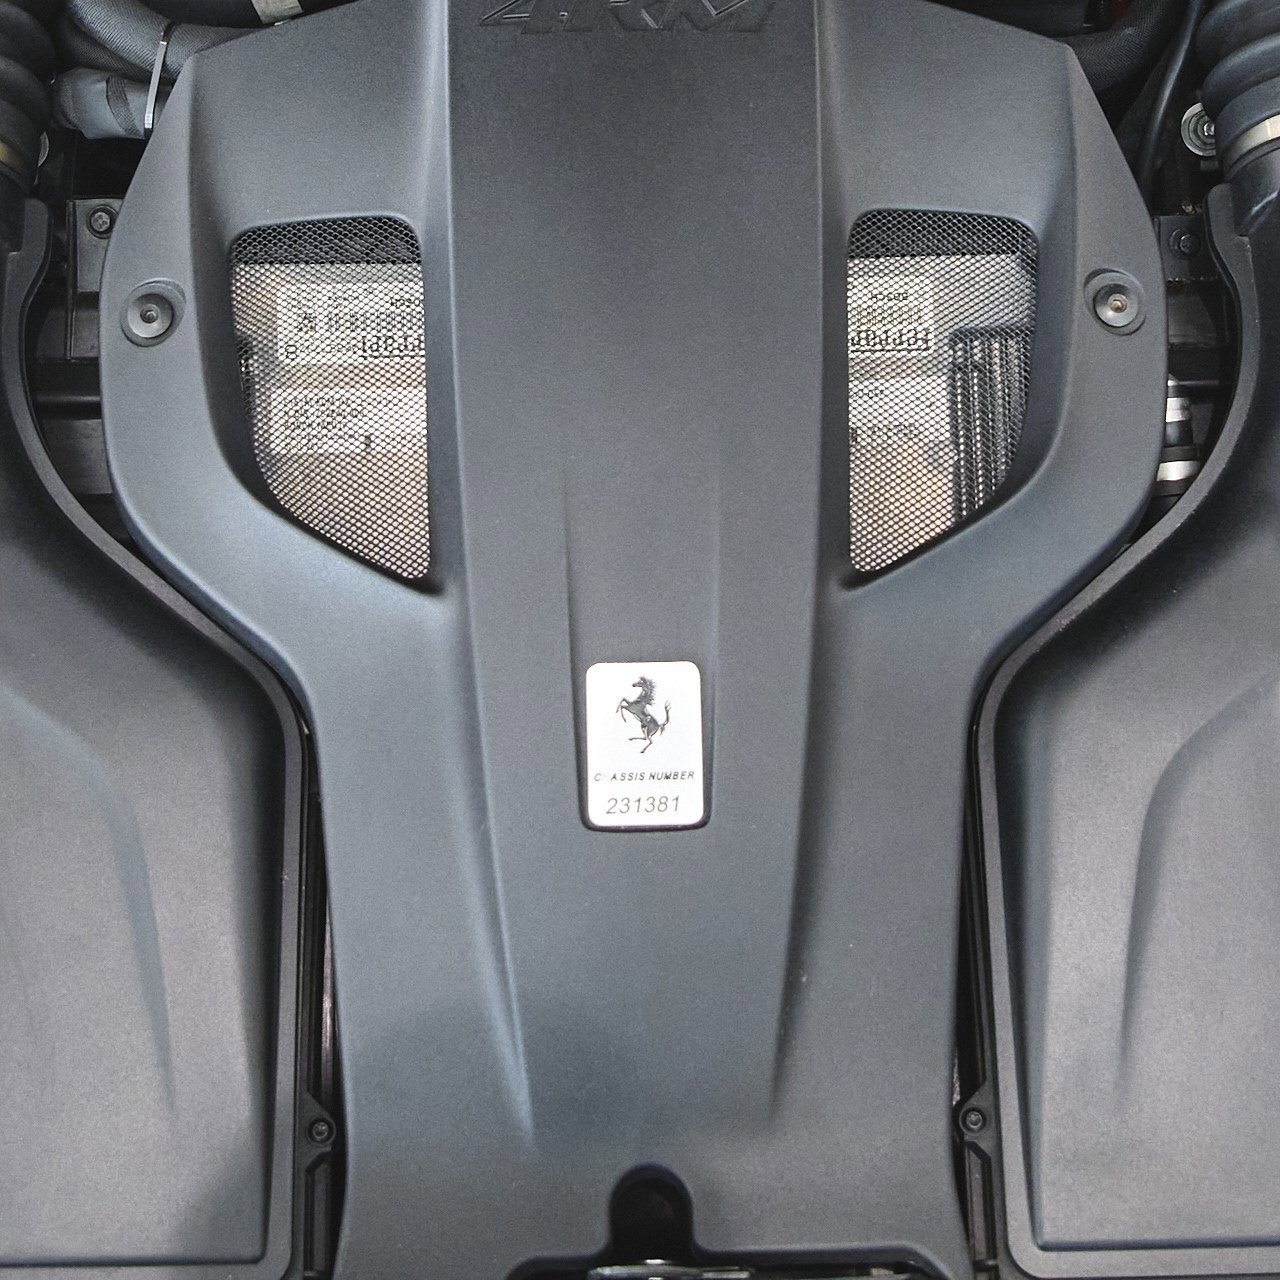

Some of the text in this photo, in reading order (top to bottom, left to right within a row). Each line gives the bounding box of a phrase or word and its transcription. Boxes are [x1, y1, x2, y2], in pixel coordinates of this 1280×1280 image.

[594, 770, 695, 782] CASSIS NUMBER
[606, 795, 680, 815] 231381
